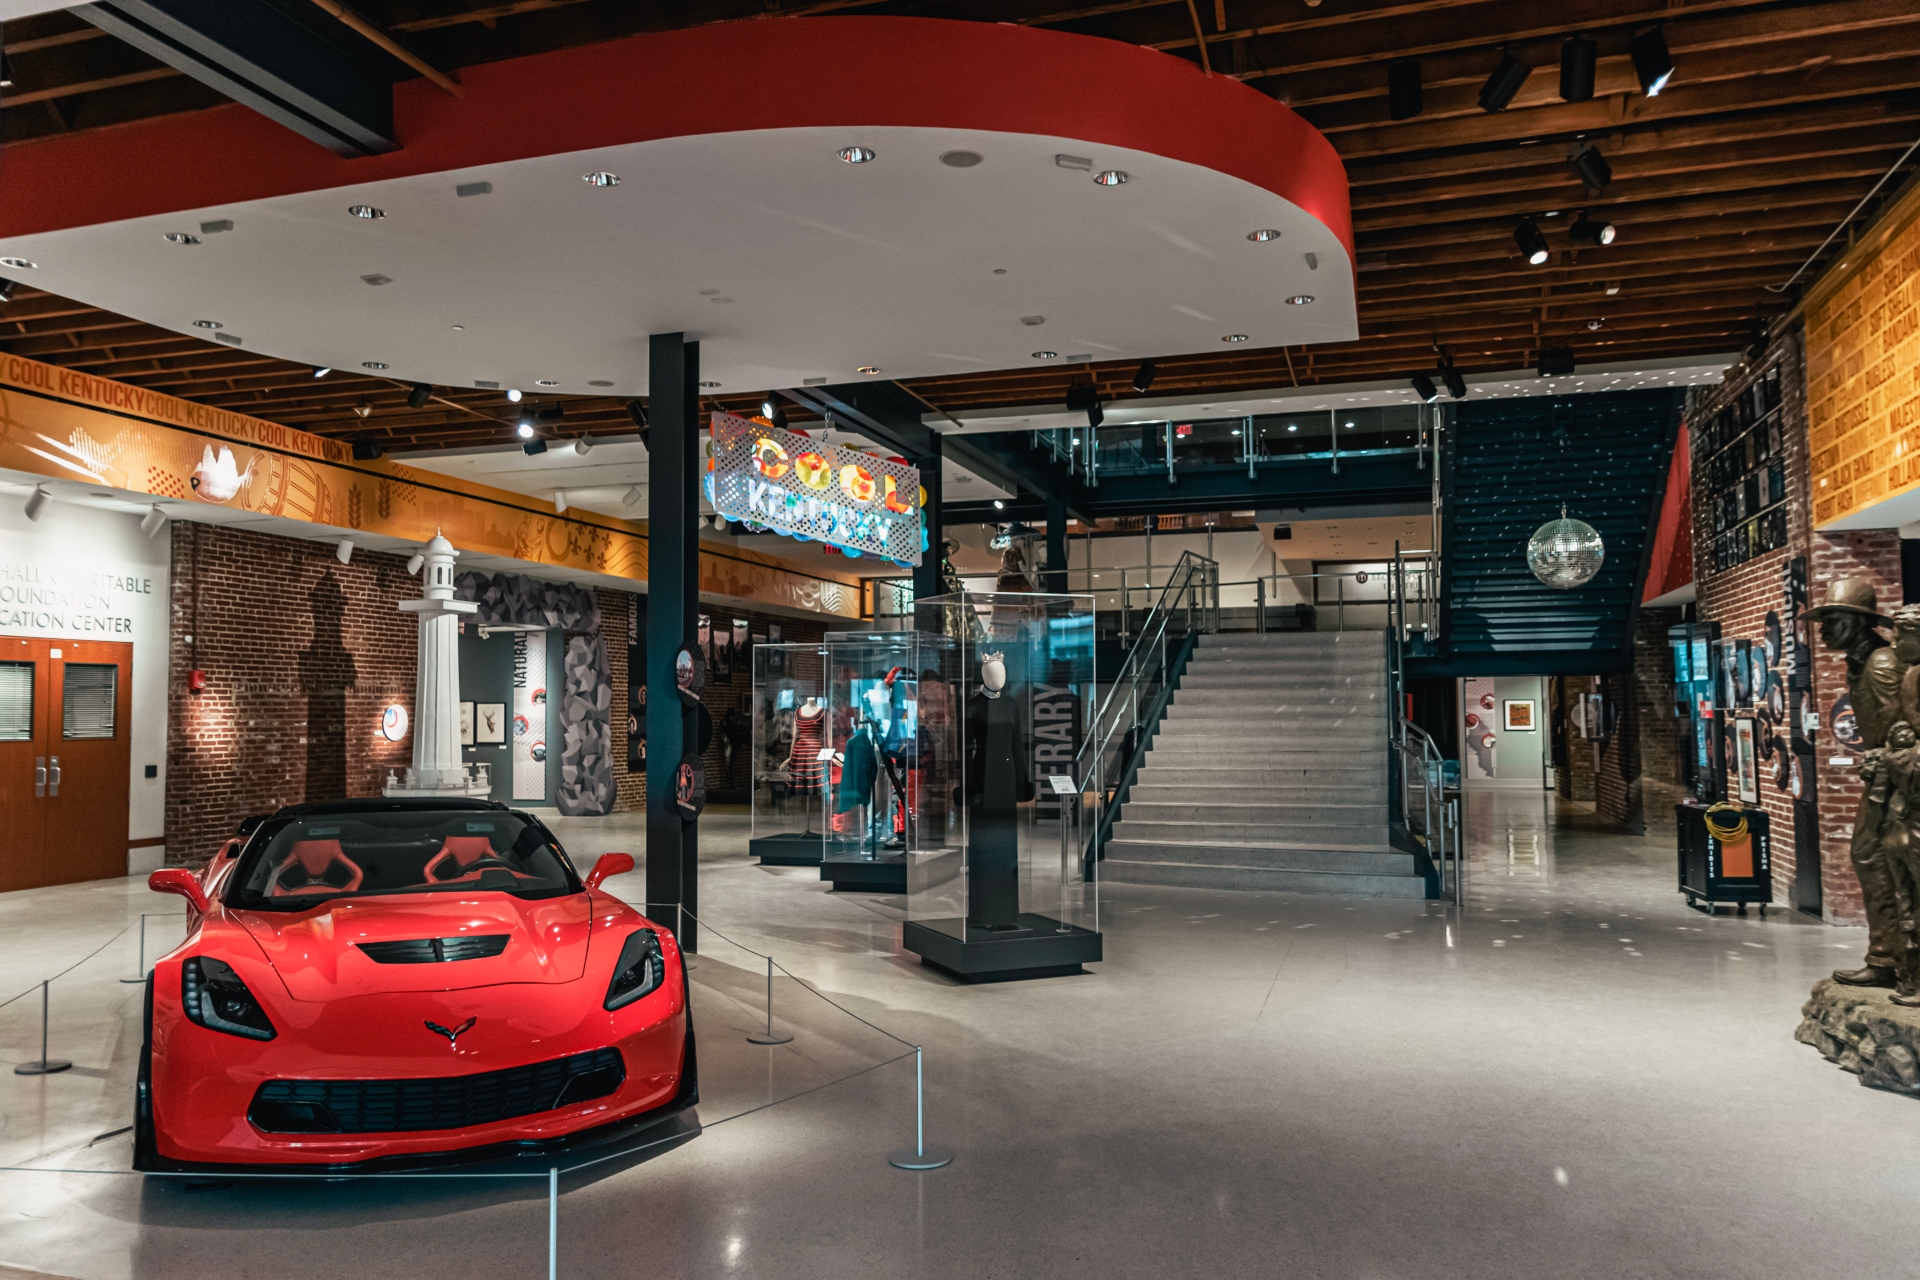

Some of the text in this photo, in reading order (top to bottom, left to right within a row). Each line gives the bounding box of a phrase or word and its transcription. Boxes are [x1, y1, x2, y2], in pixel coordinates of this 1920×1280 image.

[9, 357, 54, 391] COOL
[59, 369, 144, 412] KENTUCKY
[145, 392, 182, 422] COOL
[186, 403, 257, 439] KENTUCKY
[258, 422, 289, 448] COOL
[292, 430, 350, 463] KENTUCKY
[751, 438, 914, 516] COOL
[748, 478, 892, 550] KENTUCKY
[50, 569, 152, 594] CHARITABLE
[72, 614, 132, 633] CENTER
[629, 593, 637, 645] FAMOUS
[1782, 562, 1796, 675] MUSICAL
[514, 631, 527, 688] NATURAL
[1034, 681, 1073, 826] LITERARY
